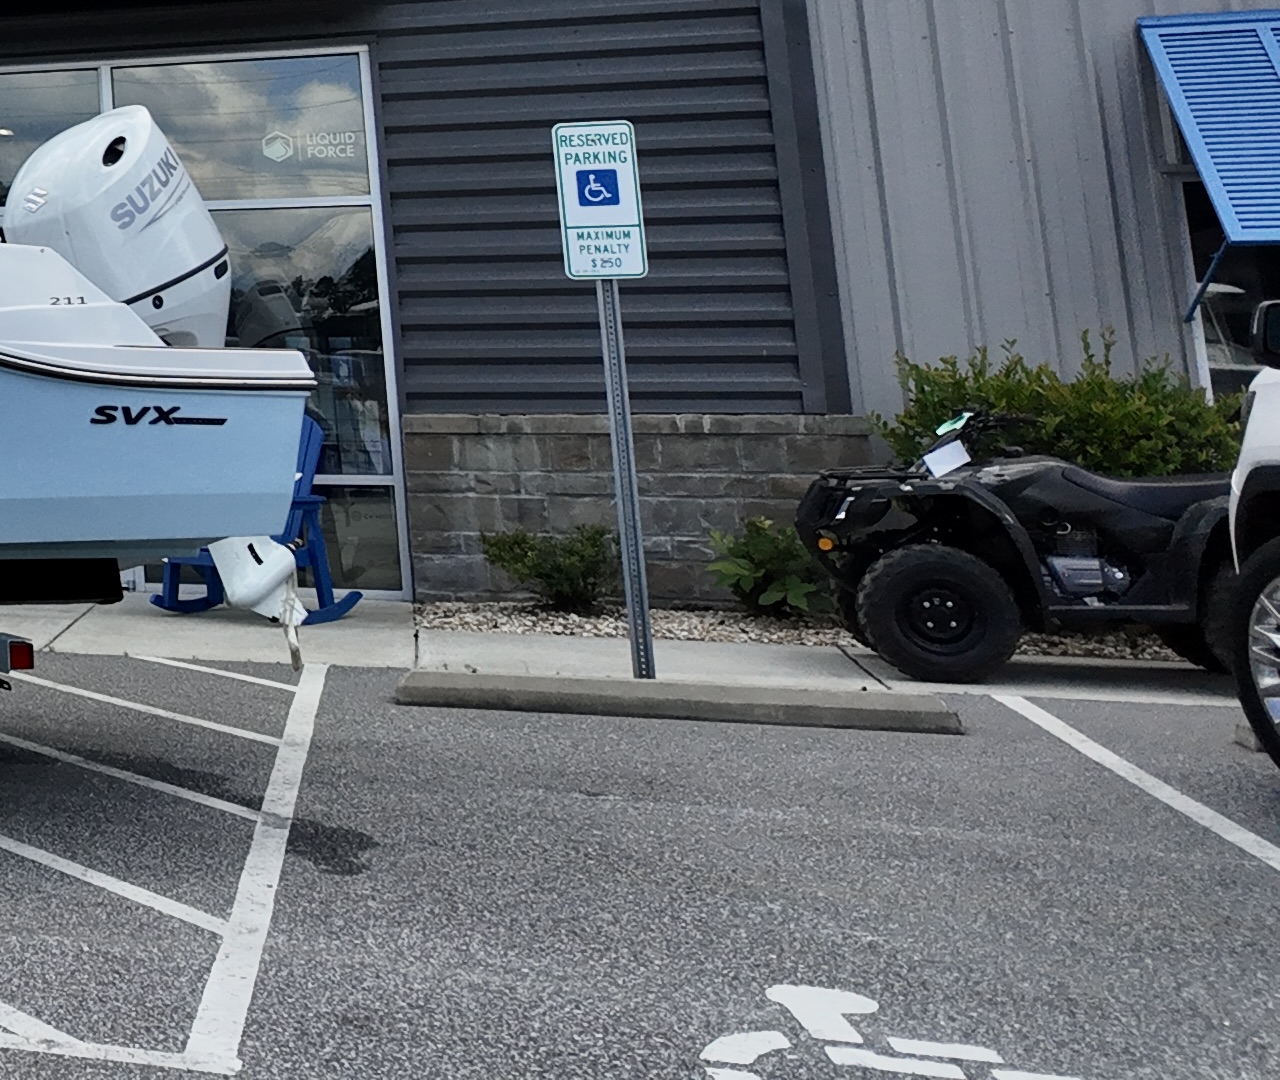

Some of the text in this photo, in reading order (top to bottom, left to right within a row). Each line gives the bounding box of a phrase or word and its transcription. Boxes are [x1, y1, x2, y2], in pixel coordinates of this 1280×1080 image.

[306, 132, 355, 145] LIQUID
[560, 132, 628, 147] RESERVED
[307, 145, 355, 158] FORCE
[565, 150, 627, 165] PARKING
[110, 146, 179, 230] SUZUKI
[576, 230, 631, 241] MAXIMUM
[579, 244, 630, 255] PENALTY
[49, 296, 87, 305] 211
[90, 405, 181, 425] SVX
